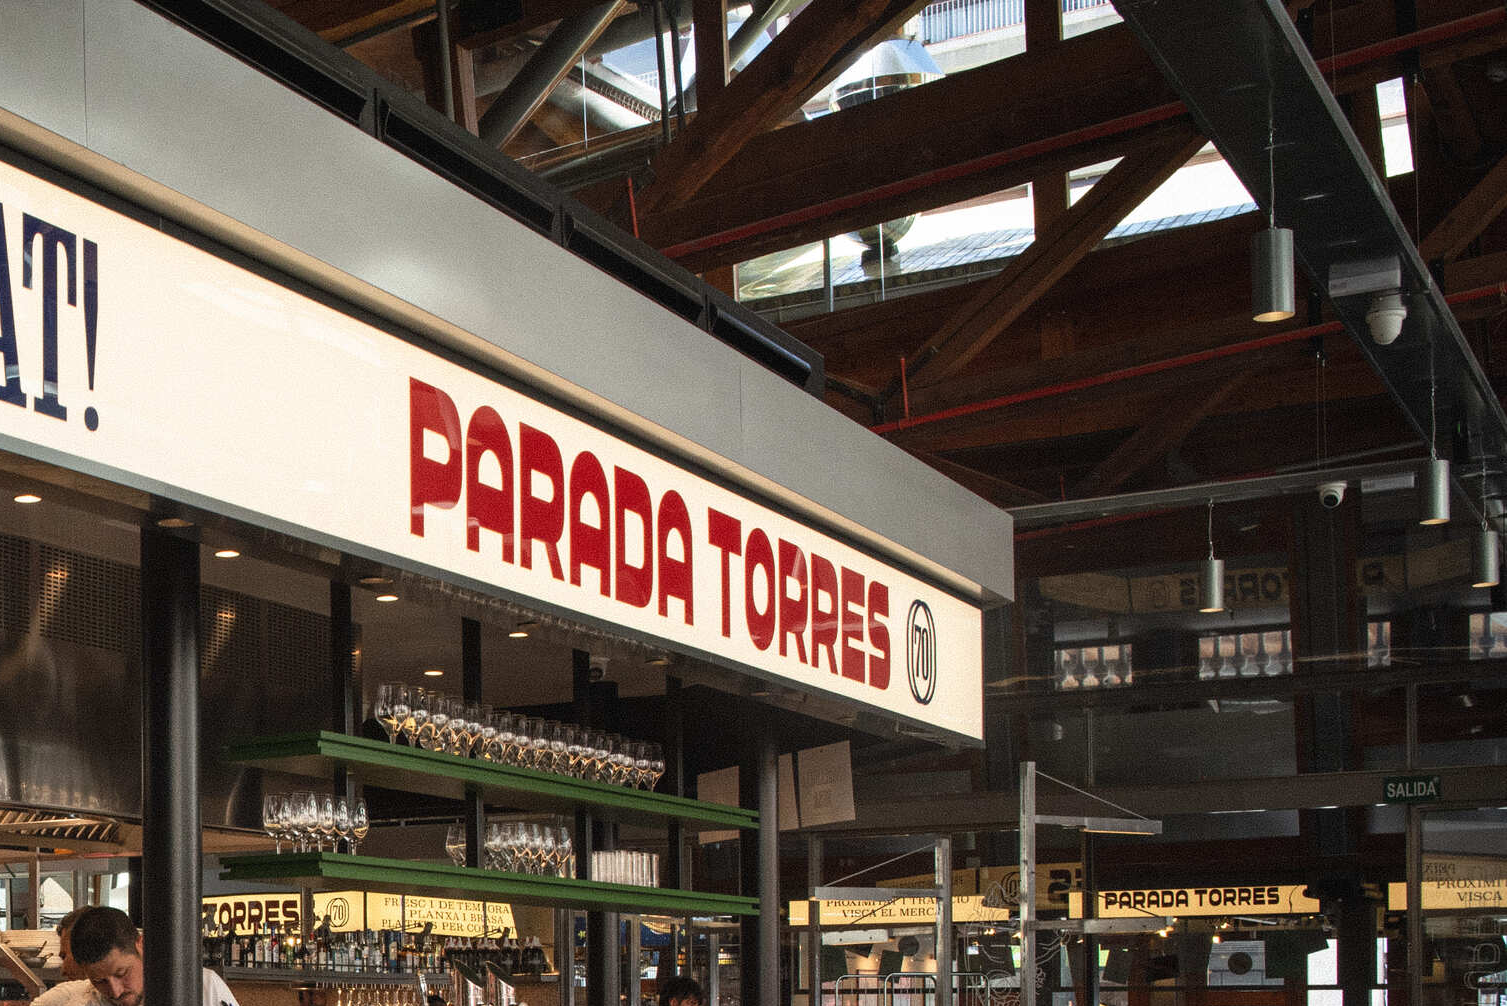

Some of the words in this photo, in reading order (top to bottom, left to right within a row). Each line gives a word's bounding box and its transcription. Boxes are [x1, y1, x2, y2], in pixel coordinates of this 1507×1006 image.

[409, 376, 693, 626] PARADA
[708, 507, 890, 690] TORRES
[1387, 781, 1437, 797] SALIDA
[1437, 878, 1507, 889] PROXIMI
[1104, 889, 1189, 909] PARADA
[1195, 887, 1280, 906] TORRES
[1457, 891, 1502, 901] VISCA
[457, 901, 510, 914] TEMORA
[881, 908, 896, 917] EL
[410, 909, 460, 922] PLANXA
[442, 922, 464, 932] PER
